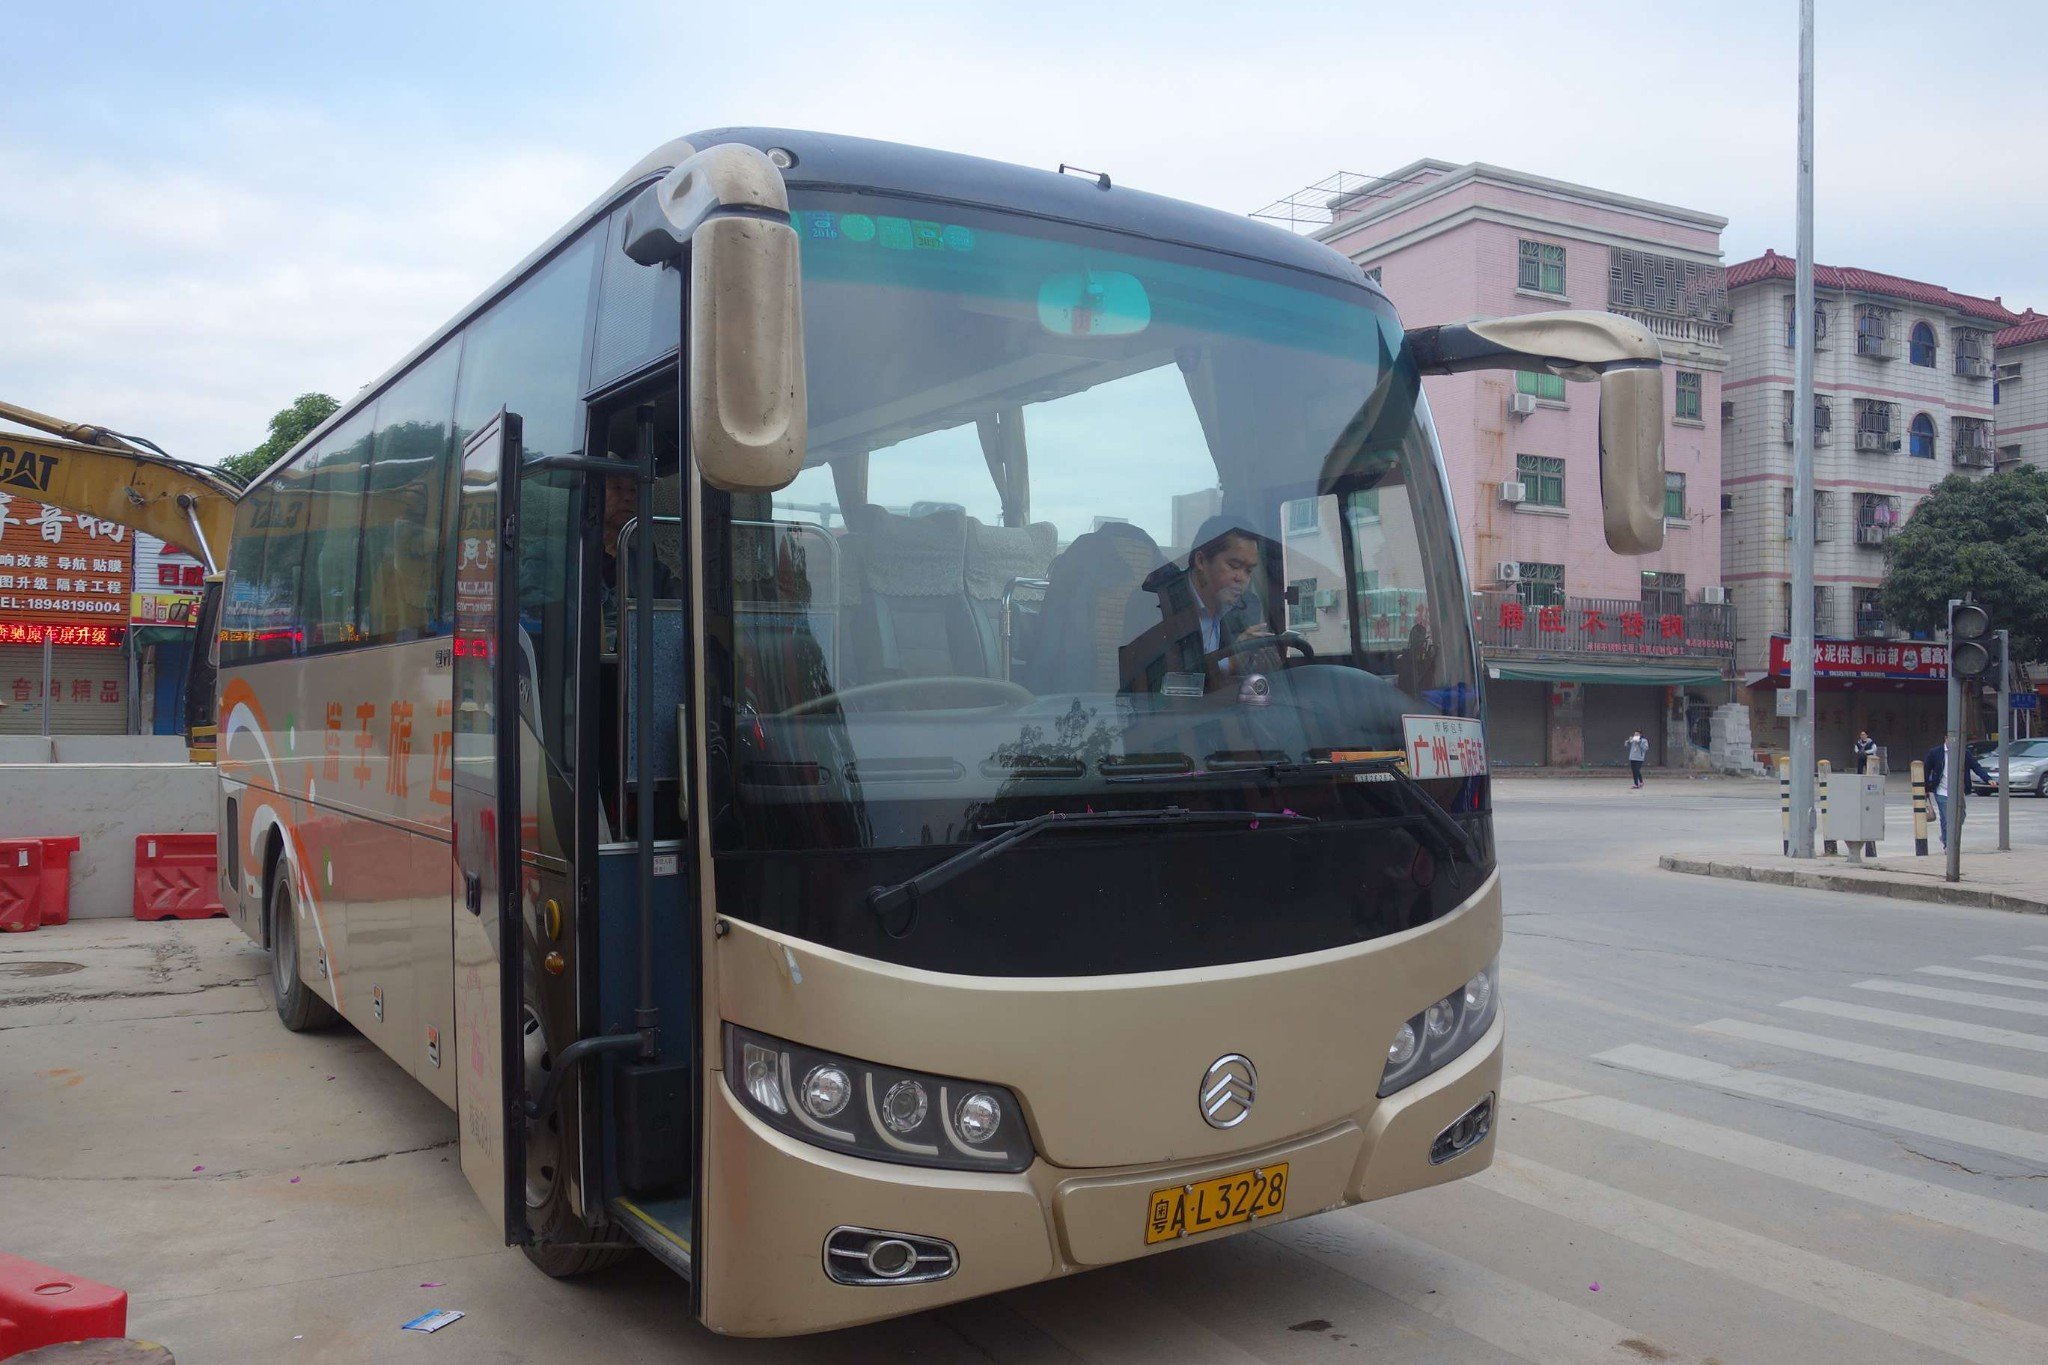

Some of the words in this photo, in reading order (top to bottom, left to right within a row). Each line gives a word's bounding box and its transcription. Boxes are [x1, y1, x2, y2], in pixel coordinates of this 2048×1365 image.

[0, 446, 58, 491] CAT
[57, 556, 87, 571] 导航
[93, 558, 122, 573] 贴膜
[56, 578, 121, 594] 隔音工程
